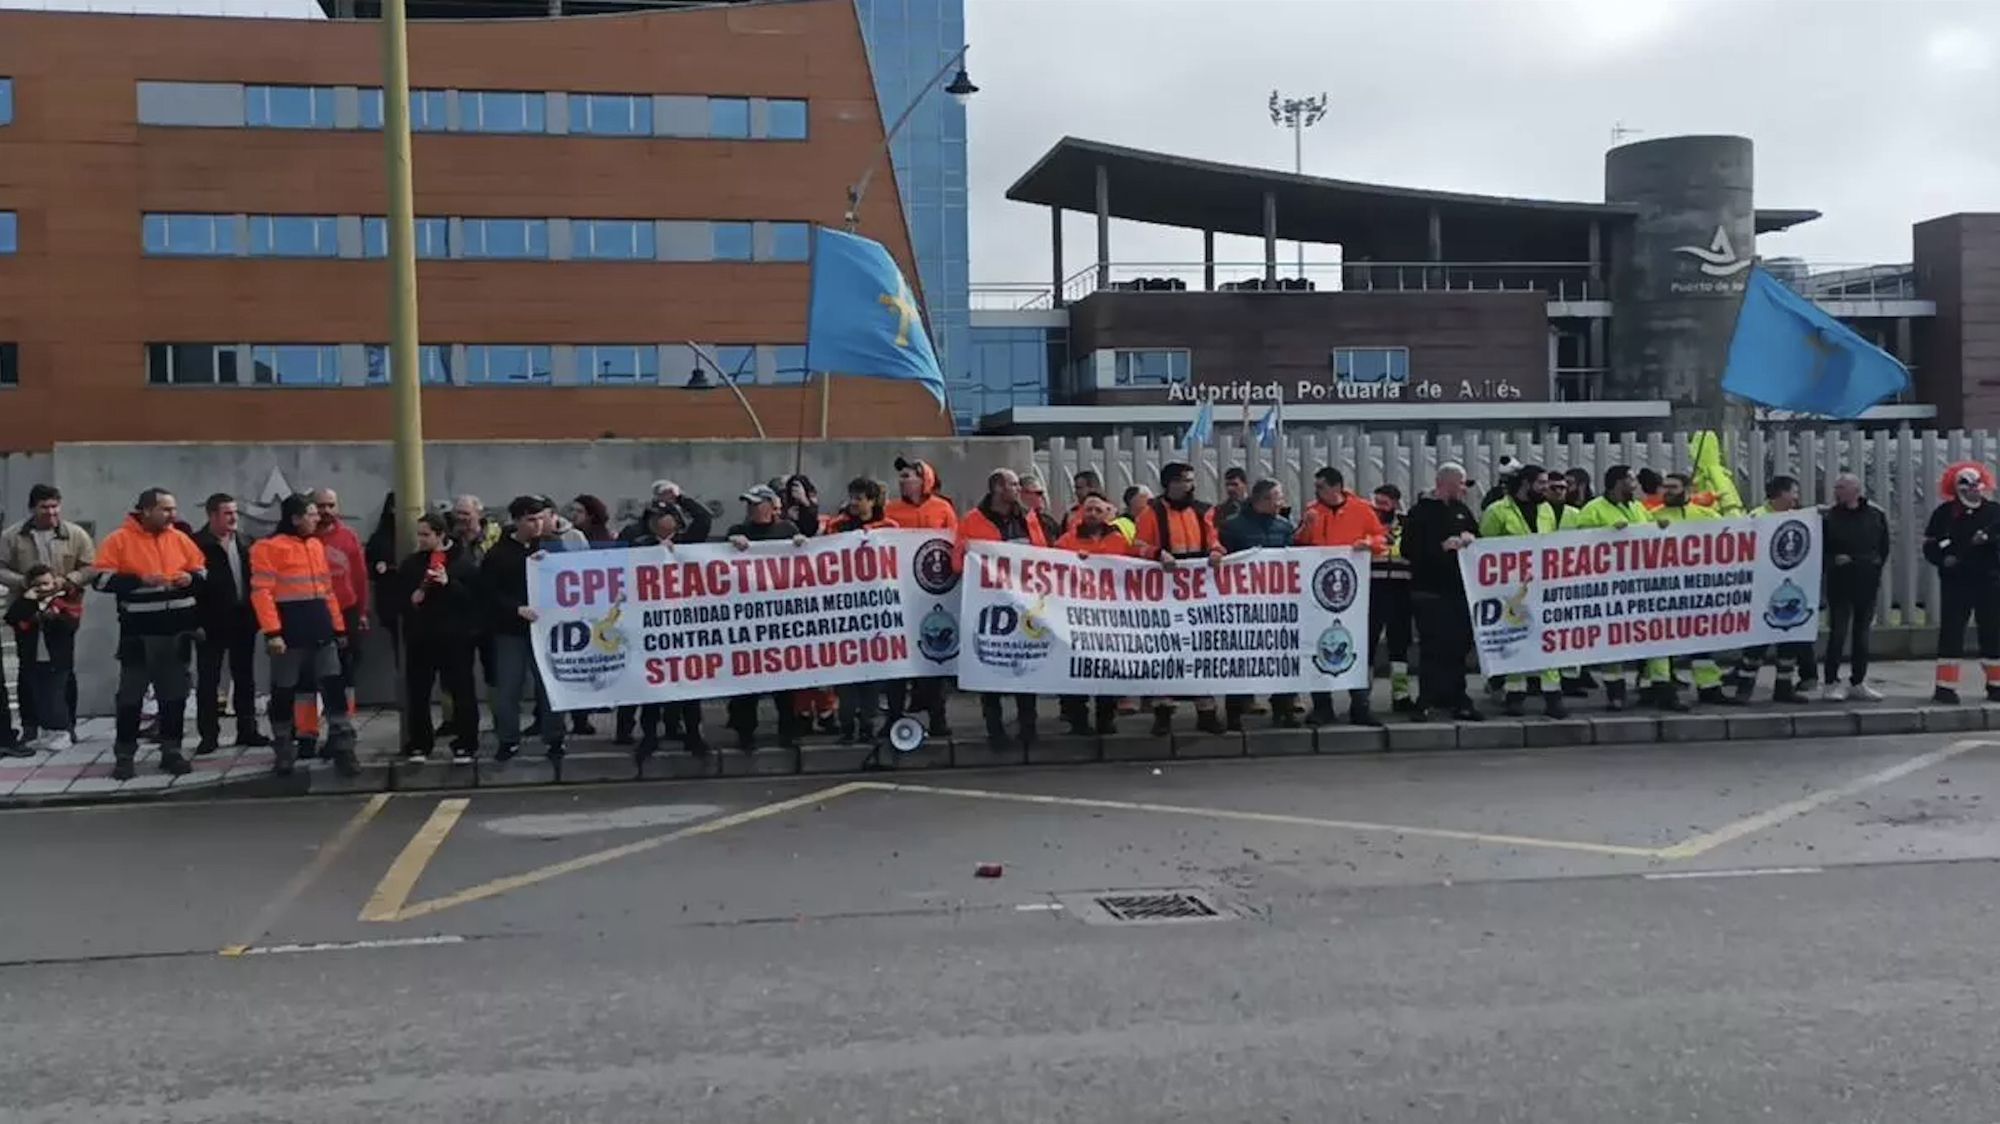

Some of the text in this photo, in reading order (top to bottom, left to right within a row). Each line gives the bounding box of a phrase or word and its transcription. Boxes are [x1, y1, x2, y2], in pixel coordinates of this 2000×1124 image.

[1168, 379, 1520, 400] Autoridad Portuaria de Avilés
[636, 539, 898, 601] REACTIVACIÓN
[1542, 527, 1757, 582] REACTIVACIÓN
[981, 554, 1012, 589] LA
[1021, 559, 1116, 601] ESTIBA
[1125, 568, 1163, 602] NO
[1173, 567, 1207, 601] SE
[1213, 560, 1302, 596] VENDE
[1542, 569, 1754, 603] AUTORIDAD PORTUARIA MEDIACIÓN
[643, 587, 900, 628] AUTORIDAD PORTUARIA MEDIACIÓN
[1067, 606, 1171, 629] EVENTUALIDAD
[1188, 602, 1299, 625] SINIESTRALIDAD
[1542, 590, 1752, 624] CONTRA LA PRECARIZACIÓN
[644, 610, 904, 651] CONTRA LA PRECARIZACIÓN
[1541, 609, 1751, 653] STOP DISOLUCIÓN
[645, 632, 908, 684] STOP DISOLUCIÓN
